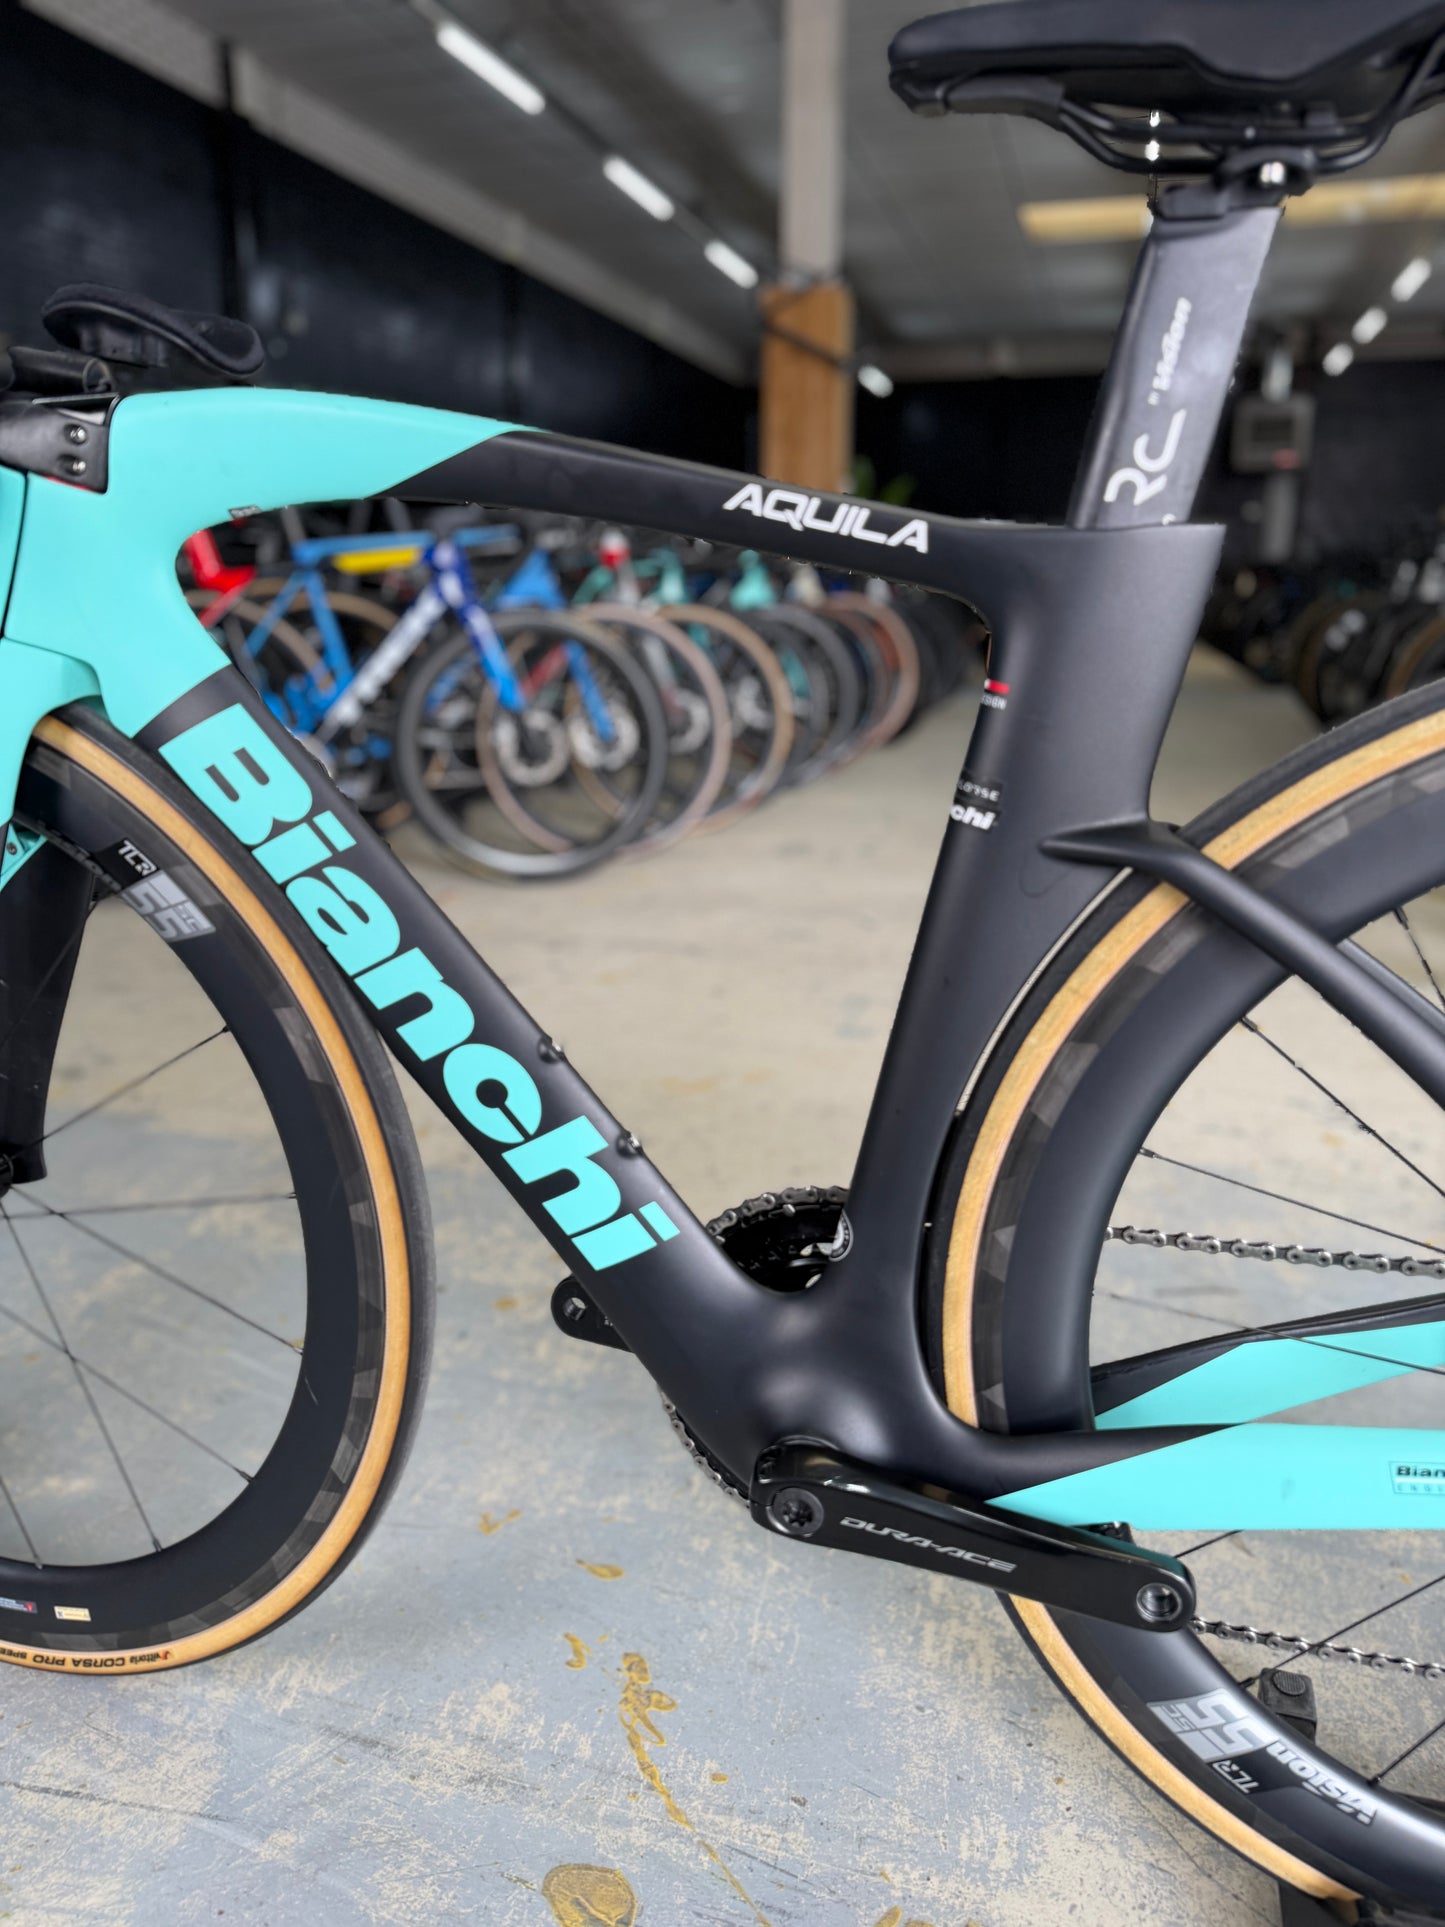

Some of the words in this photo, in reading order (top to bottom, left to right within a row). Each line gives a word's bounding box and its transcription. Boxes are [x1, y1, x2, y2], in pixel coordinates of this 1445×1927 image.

[1103, 408, 1187, 506] RC
[722, 483, 929, 554] AQUILA
[117, 839, 158, 876] TLR
[158, 703, 680, 1272] Bianchi
[840, 1516, 1018, 1573] DURA-ACE
[32, 1654, 66, 1667] PRO
[72, 1656, 126, 1667] CORSA
[1212, 1759, 1260, 1794] TLR
